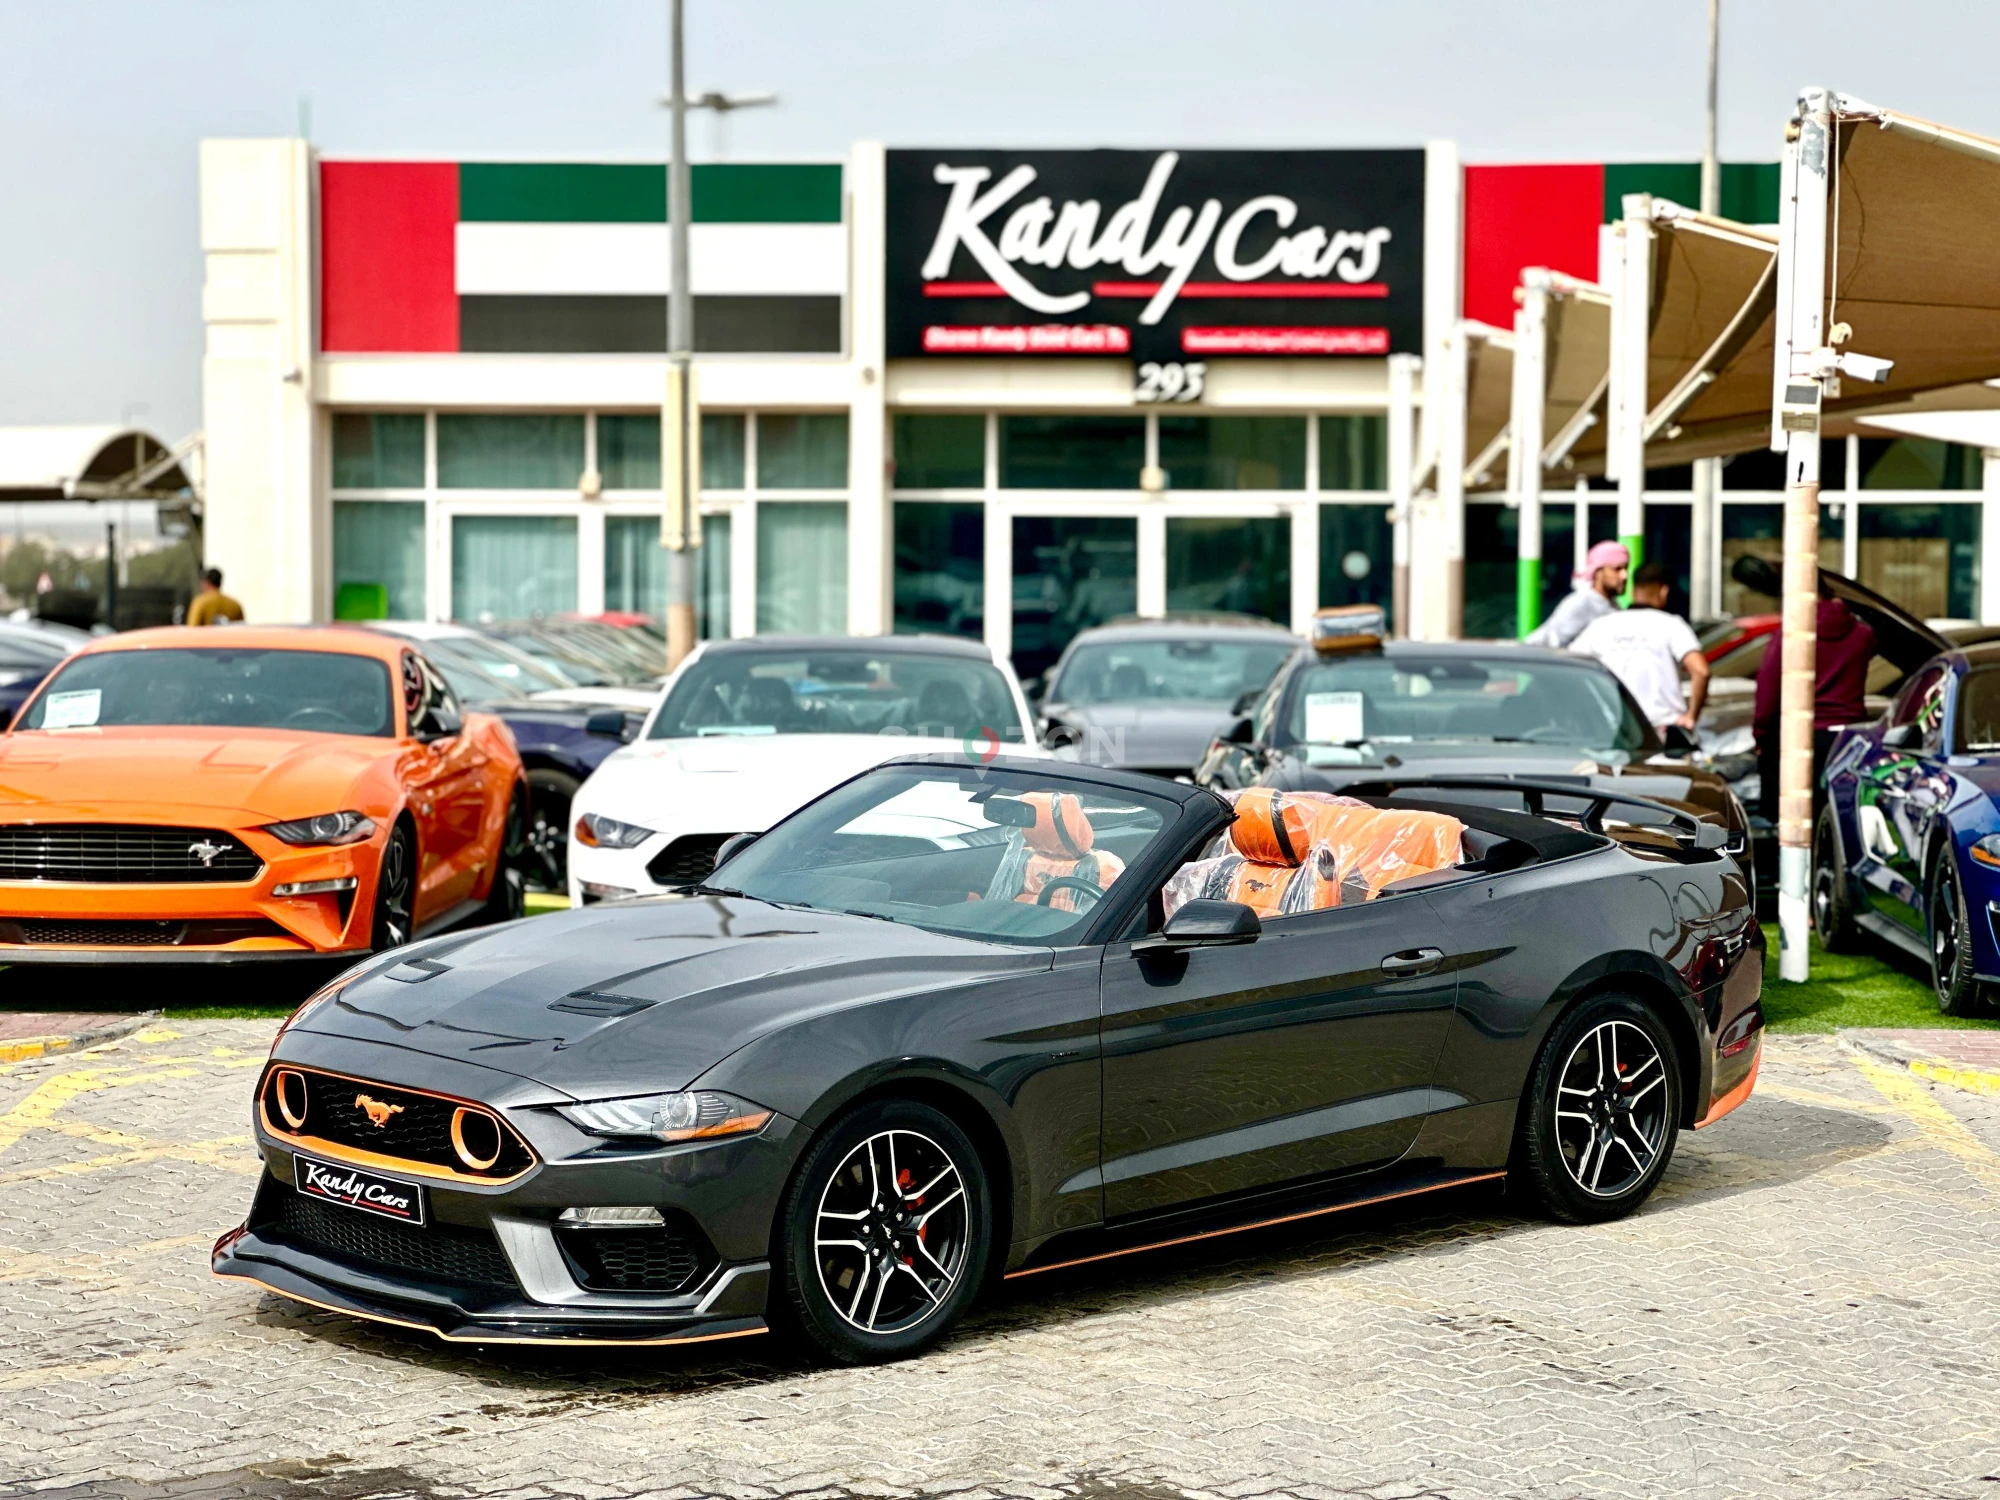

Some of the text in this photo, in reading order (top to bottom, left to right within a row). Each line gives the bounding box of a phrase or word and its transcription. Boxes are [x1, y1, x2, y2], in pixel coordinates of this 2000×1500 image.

[921, 152, 1391, 324] Kandy Cars
[1135, 361, 1207, 402] 295
[305, 1162, 409, 1208] Kandy Cars
